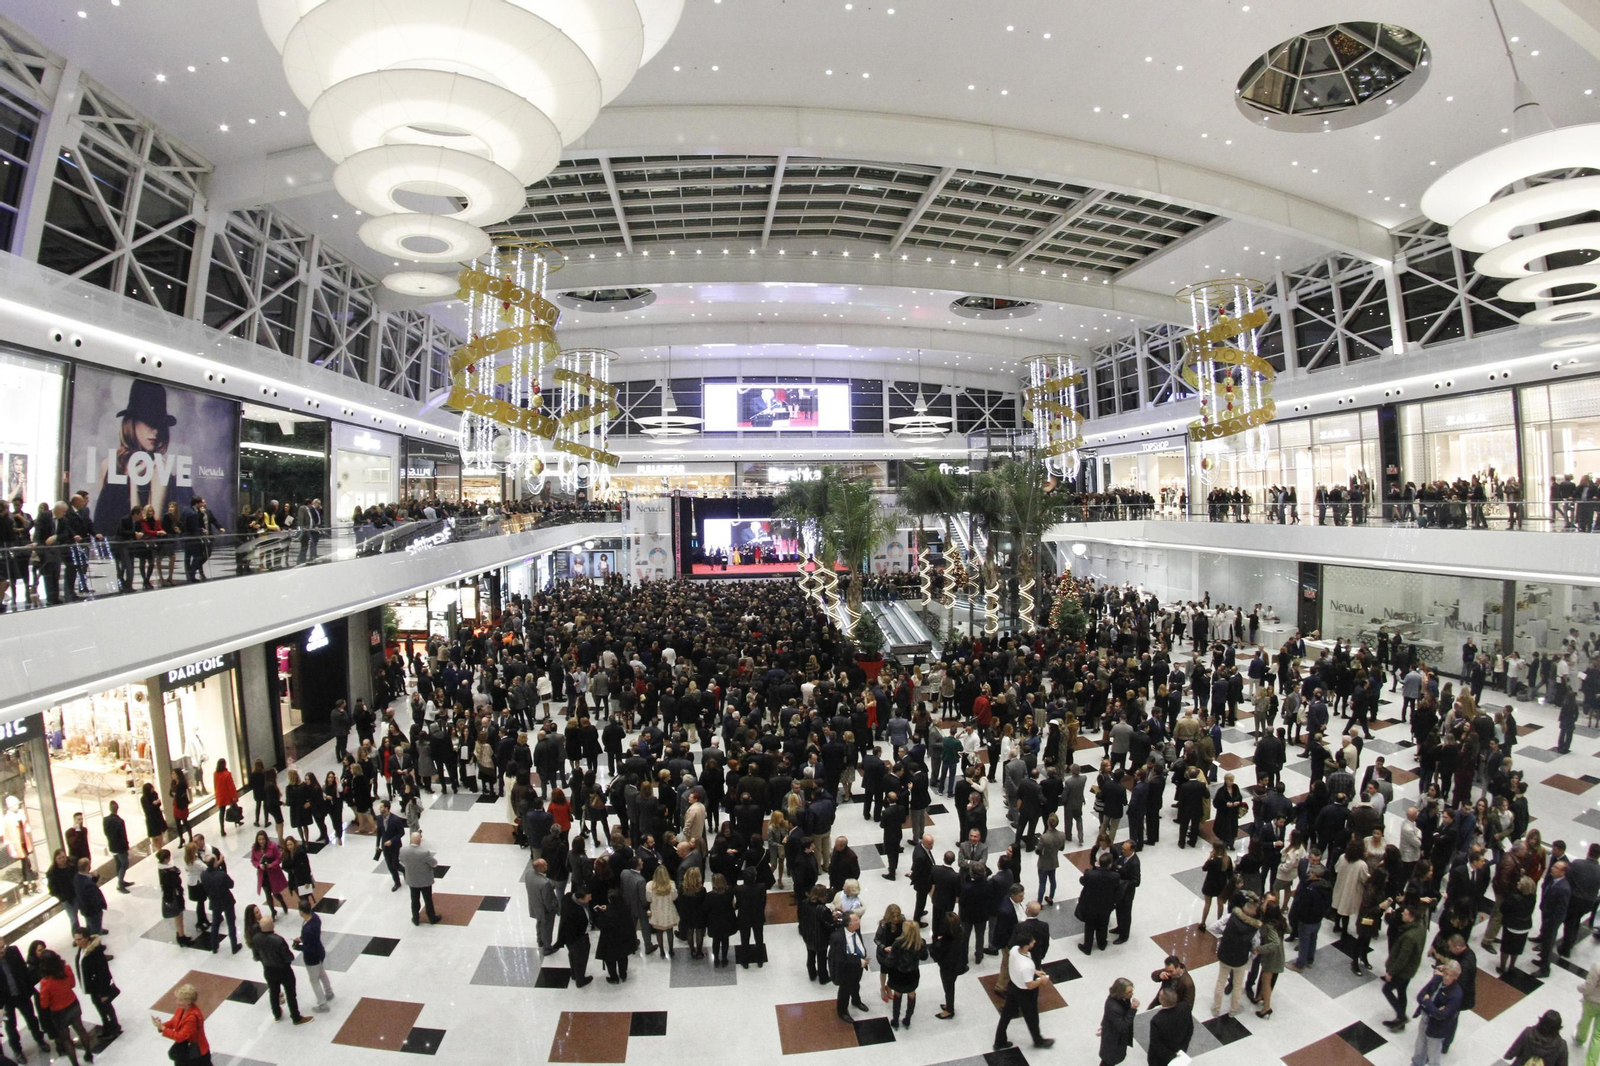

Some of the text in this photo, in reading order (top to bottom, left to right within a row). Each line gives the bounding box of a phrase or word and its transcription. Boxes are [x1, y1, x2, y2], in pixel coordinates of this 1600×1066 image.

[86, 446, 97, 483] I
[107, 448, 193, 487] LOVE
[1330, 599, 1365, 615] Nevada
[1444, 616, 1484, 633] Nevad
